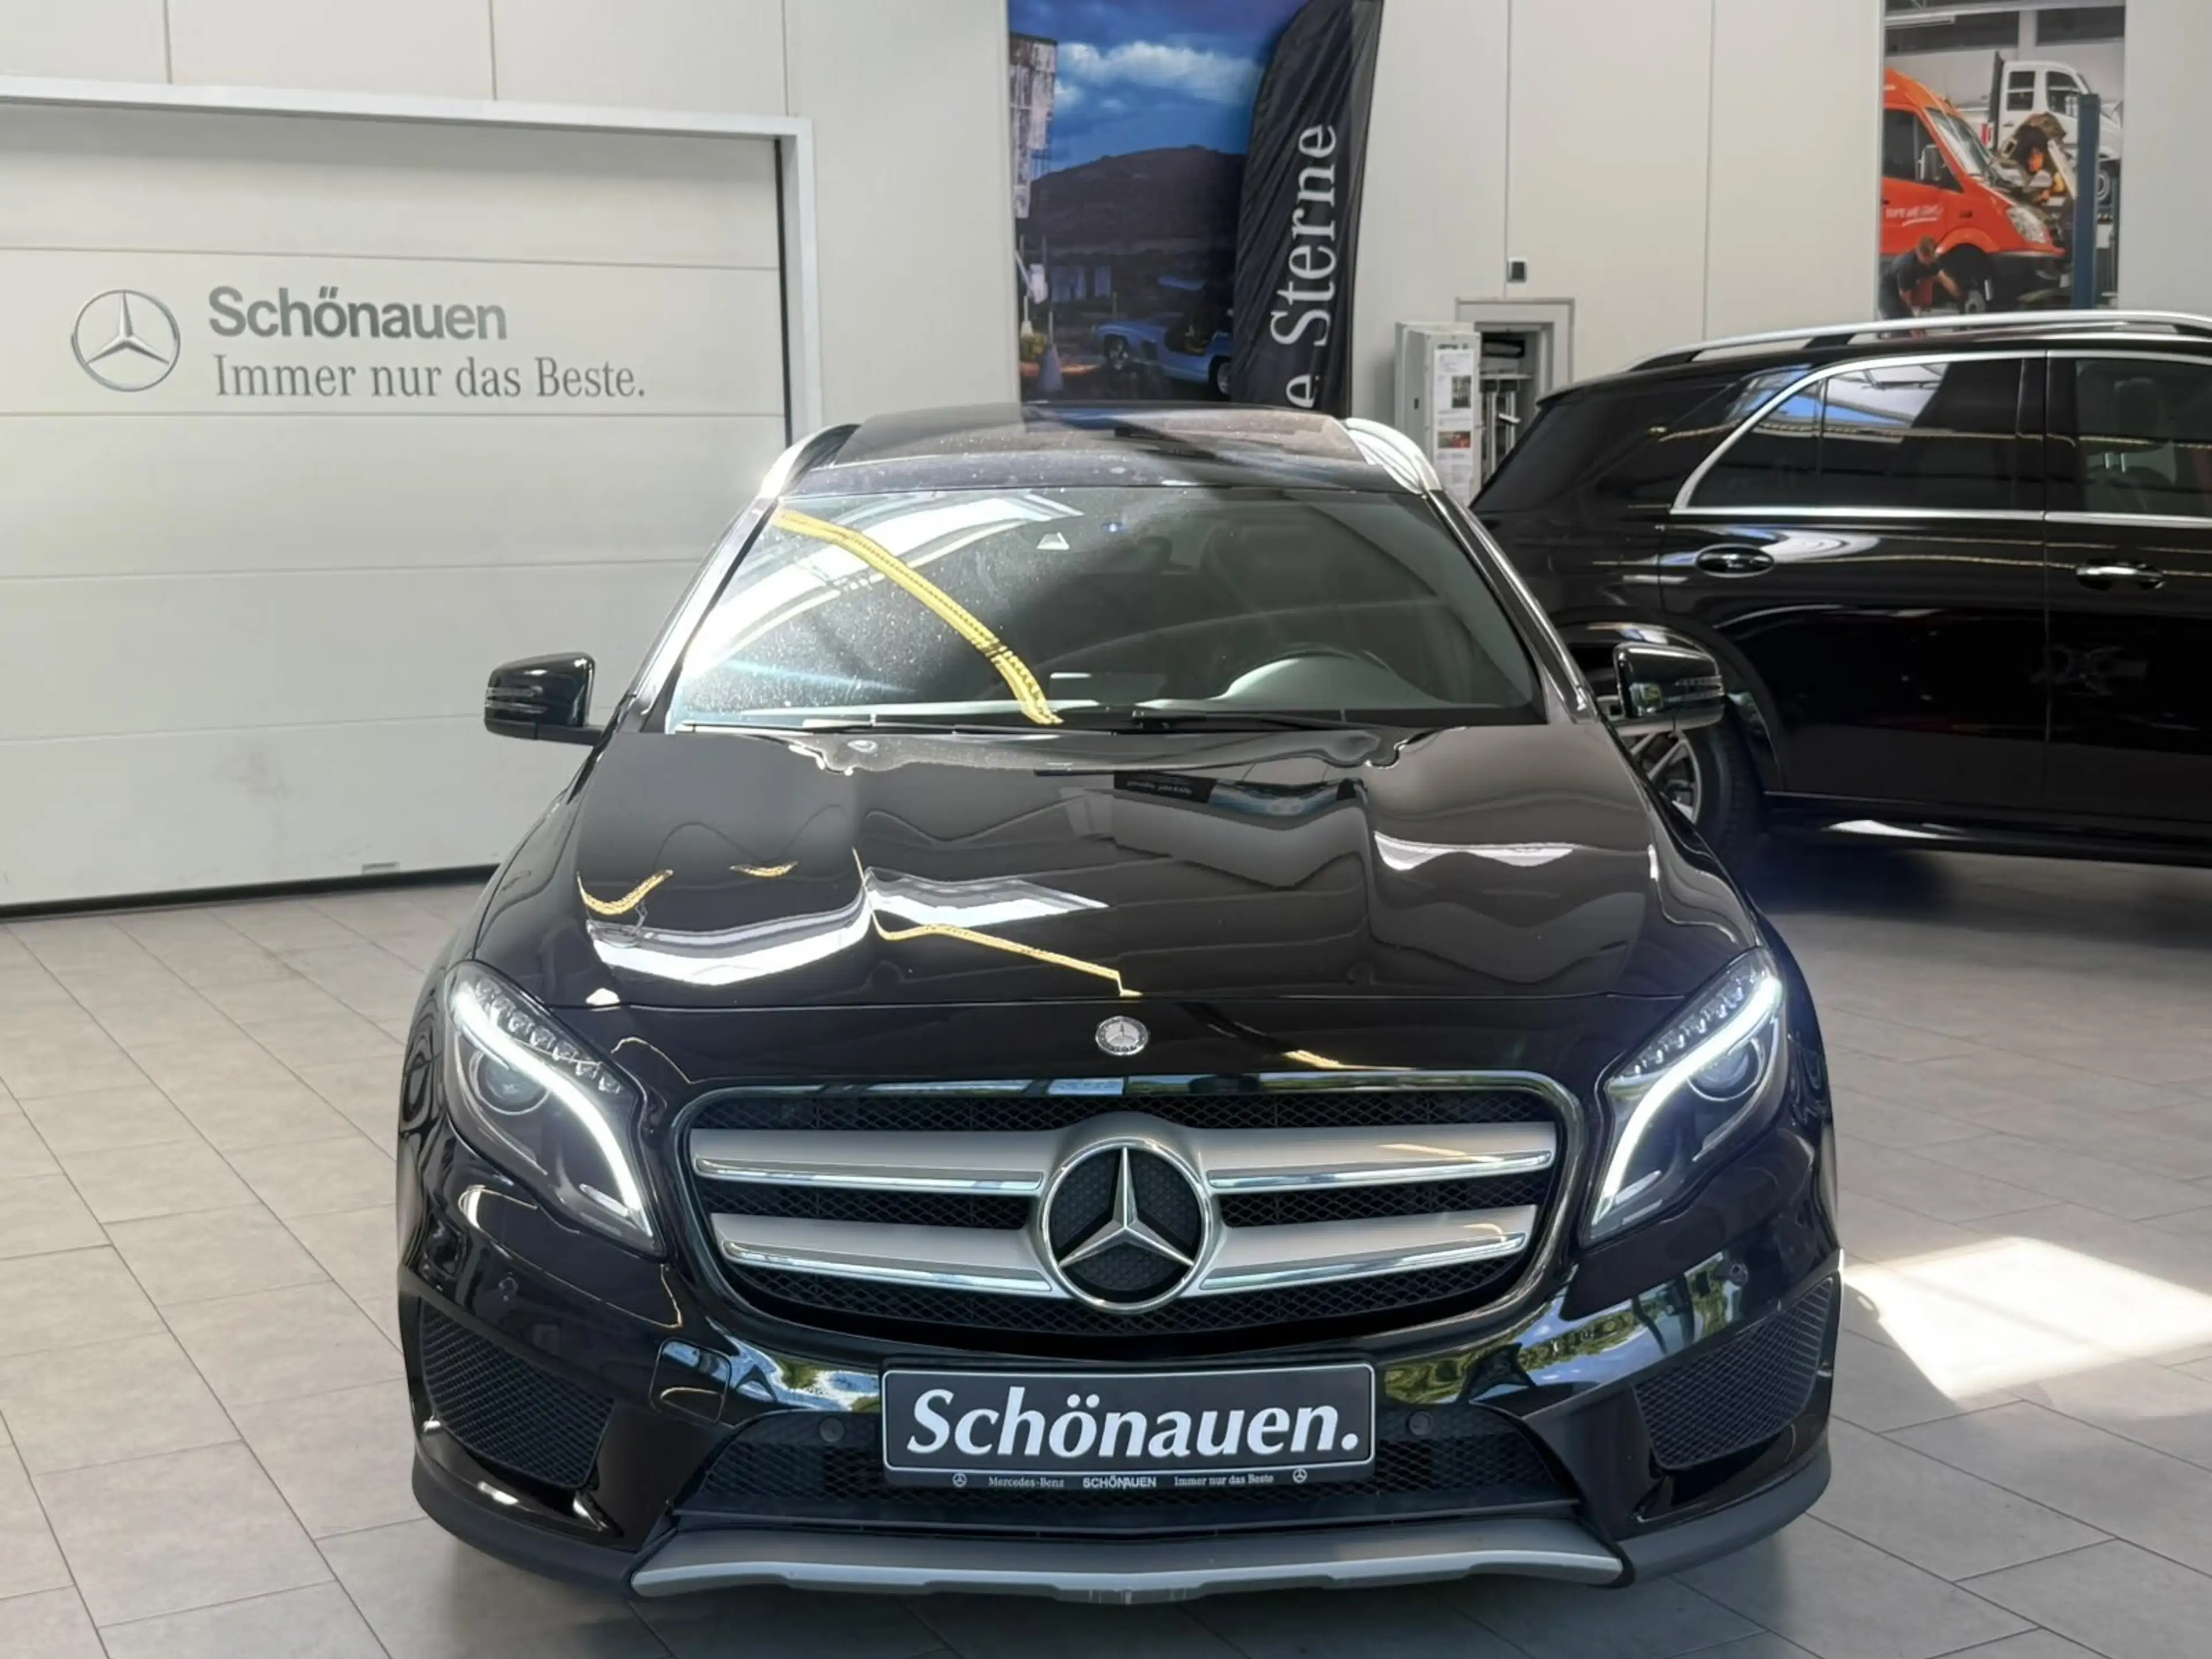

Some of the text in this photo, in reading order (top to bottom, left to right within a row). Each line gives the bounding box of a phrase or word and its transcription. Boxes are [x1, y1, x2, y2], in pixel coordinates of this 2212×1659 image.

[1270, 124, 1337, 347] Sterne
[208, 285, 507, 340] Schönauen
[213, 353, 645, 399] Immer nur das Beste.
[906, 1385, 1359, 1459] Schönauen.
[988, 1476, 1065, 1488] Mercedes-Benz
[1082, 1475, 1157, 1488] SCHÖNAUEN
[1174, 1476, 1207, 1486] Immer
[1228, 1474, 1245, 1484] das
